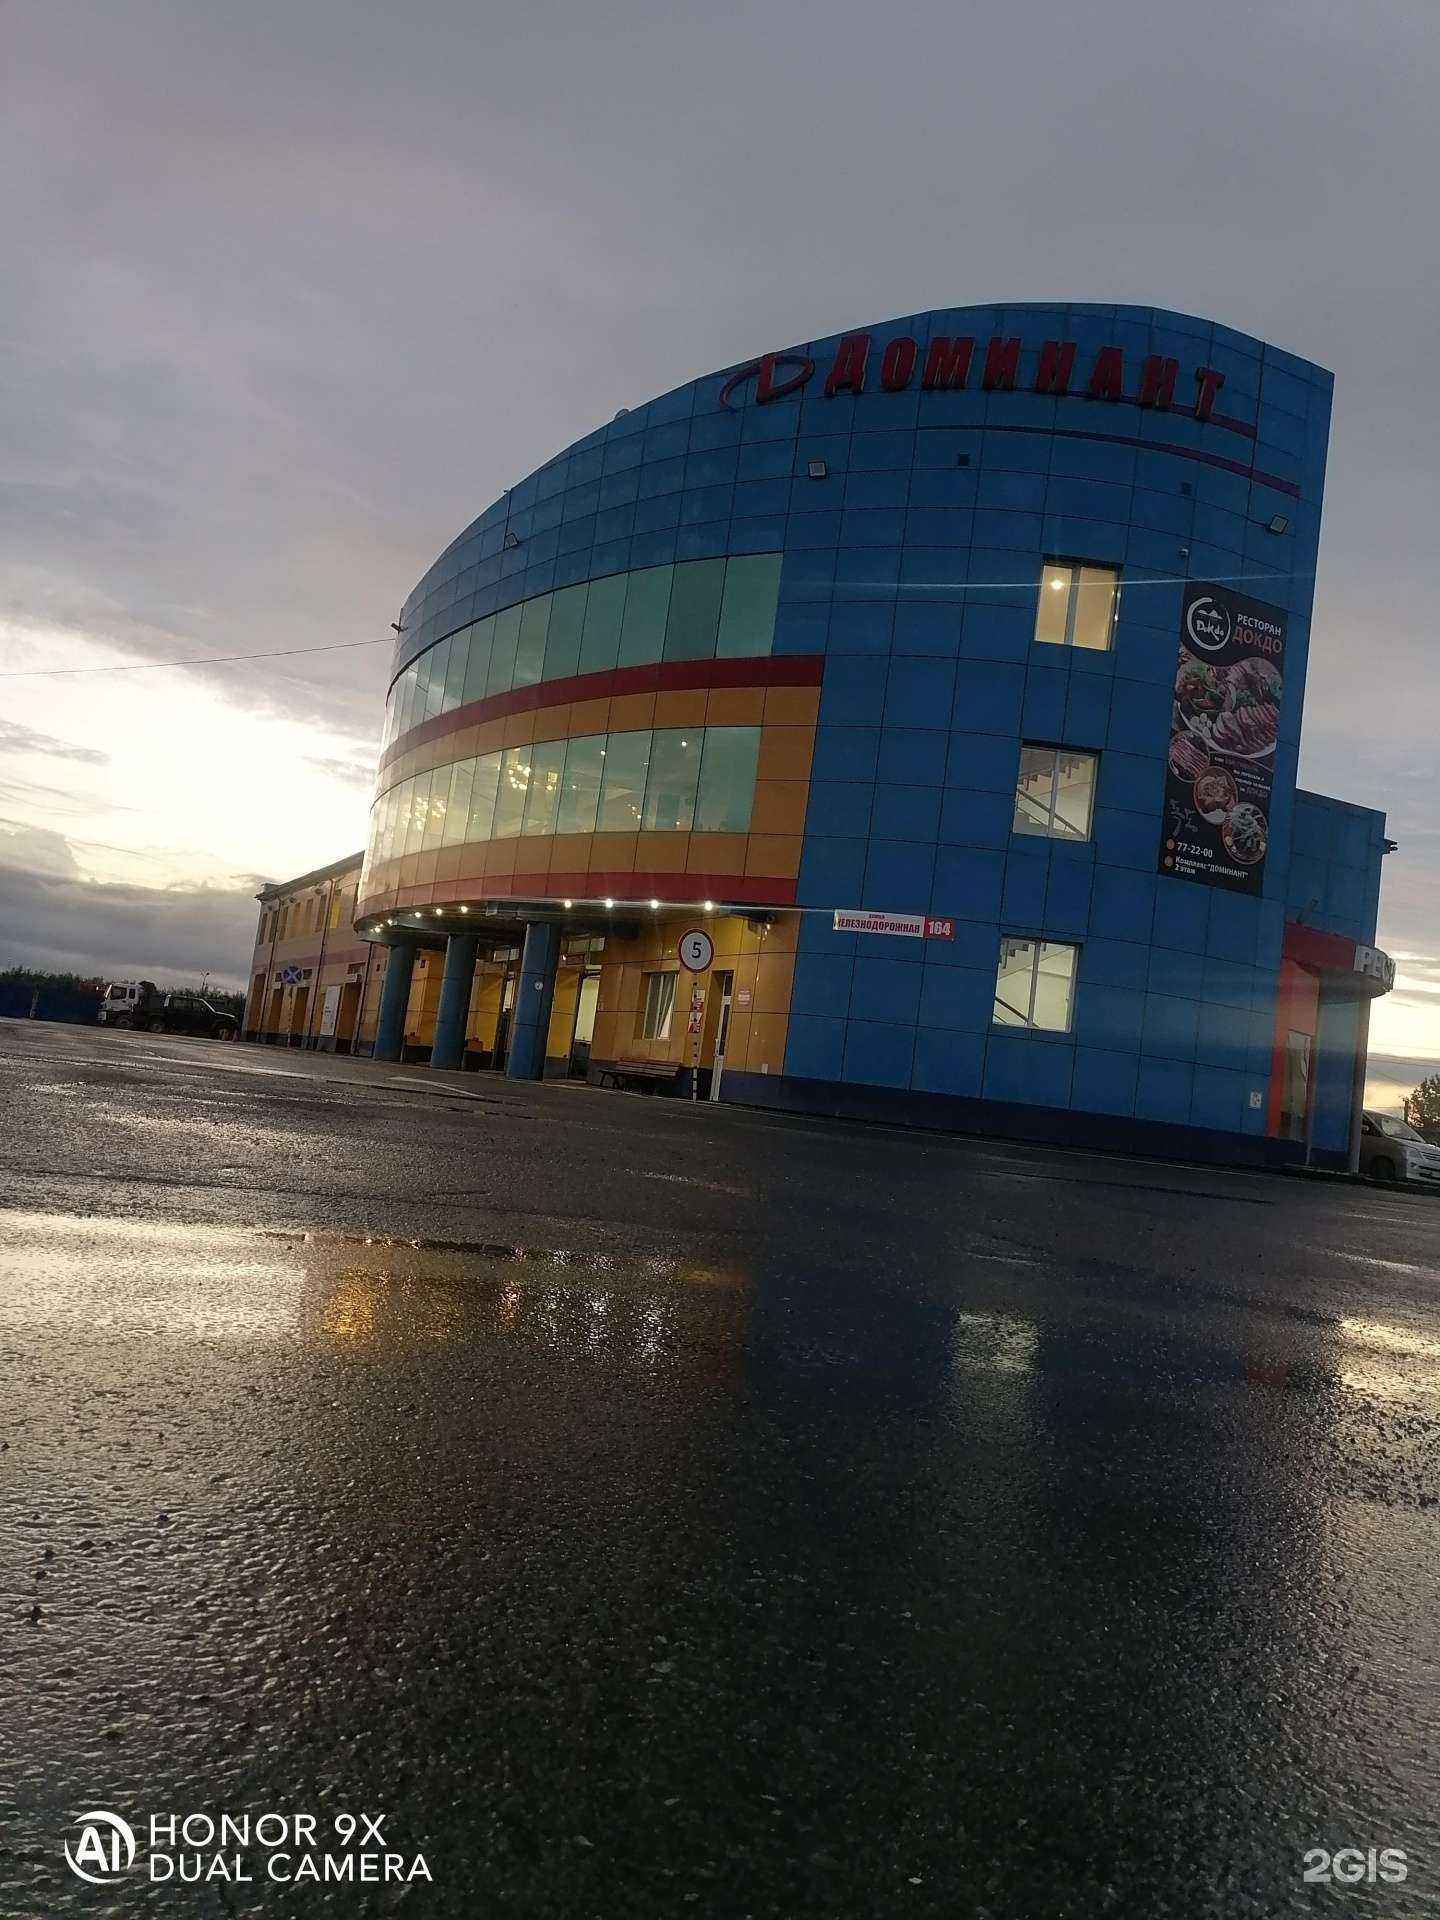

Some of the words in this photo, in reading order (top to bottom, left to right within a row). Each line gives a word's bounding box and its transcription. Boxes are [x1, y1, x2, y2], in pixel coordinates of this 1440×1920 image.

[823, 333, 1225, 419] ДОМИНАНТ
[1237, 613, 1282, 636] РЕСТОРАН
[1232, 625, 1282, 656] ДОКДО
[1177, 841, 1213, 858] 77-22-00
[691, 942, 702, 958] 5
